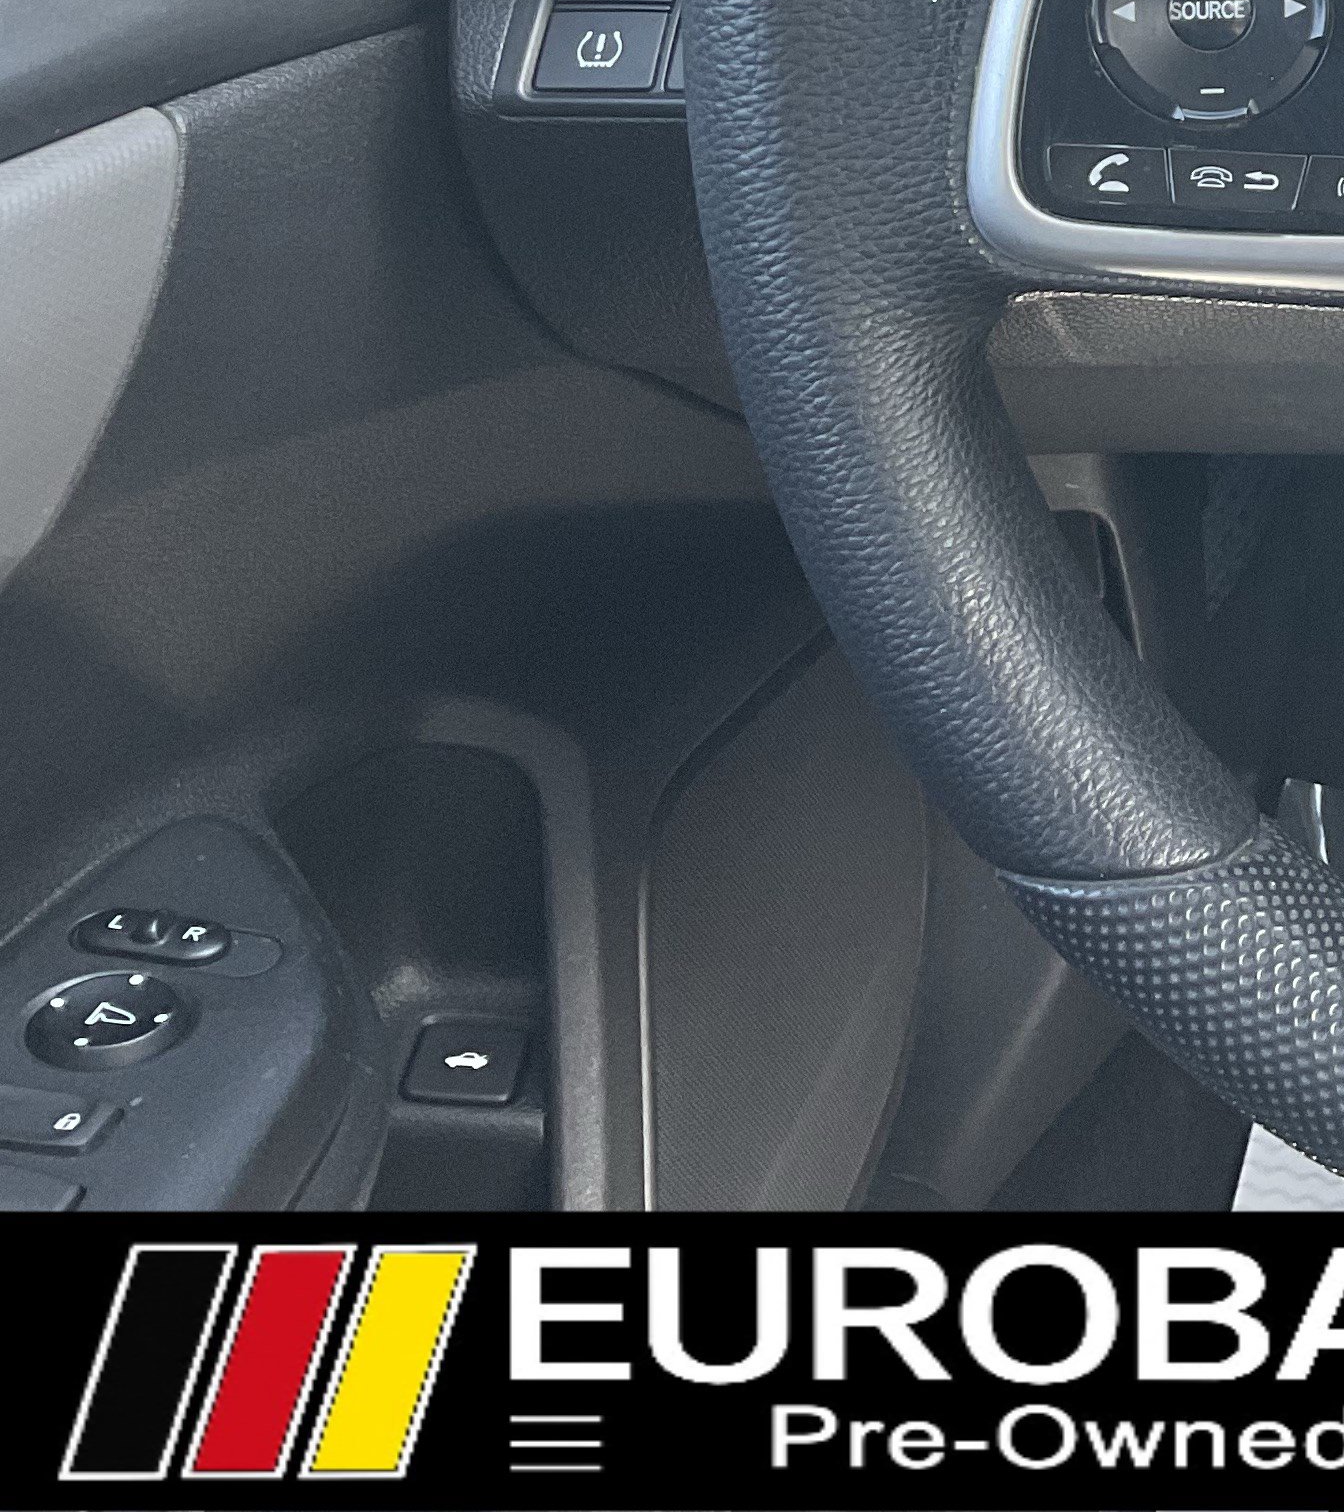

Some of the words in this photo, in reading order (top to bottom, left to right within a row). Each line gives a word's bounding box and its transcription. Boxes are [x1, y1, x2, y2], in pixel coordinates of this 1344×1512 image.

[1169, 0, 1247, 22] SOURCE
[108, 915, 122, 929] L
[182, 927, 206, 941] R
